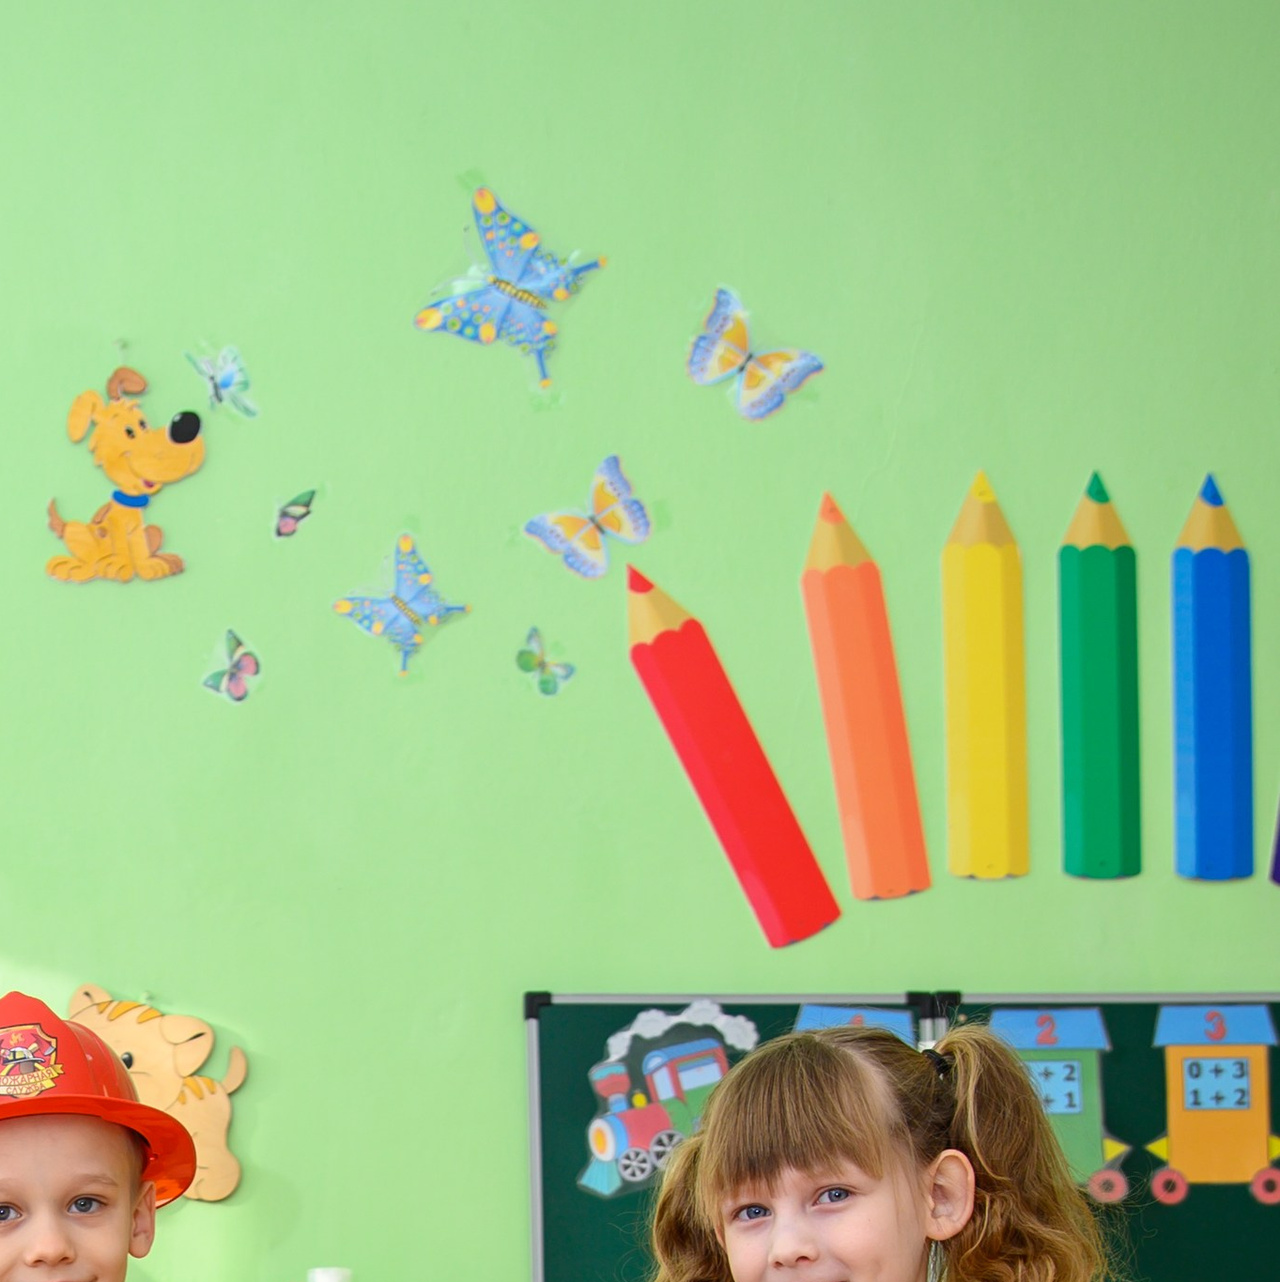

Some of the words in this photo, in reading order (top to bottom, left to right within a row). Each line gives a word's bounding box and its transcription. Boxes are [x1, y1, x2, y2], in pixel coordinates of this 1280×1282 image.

[1035, 1014, 1058, 1045] 2
[1205, 1010, 1227, 1042] 3
[1063, 1064, 1076, 1081] 2
[1187, 1061, 1202, 1079] 0
[1232, 1061, 1246, 1079] 3
[6, 1082, 47, 1095] СЛУЖБА
[1190, 1089, 1201, 1106] 1
[1234, 1088, 1248, 1106] 2
[1065, 1091, 1077, 1108] 1
